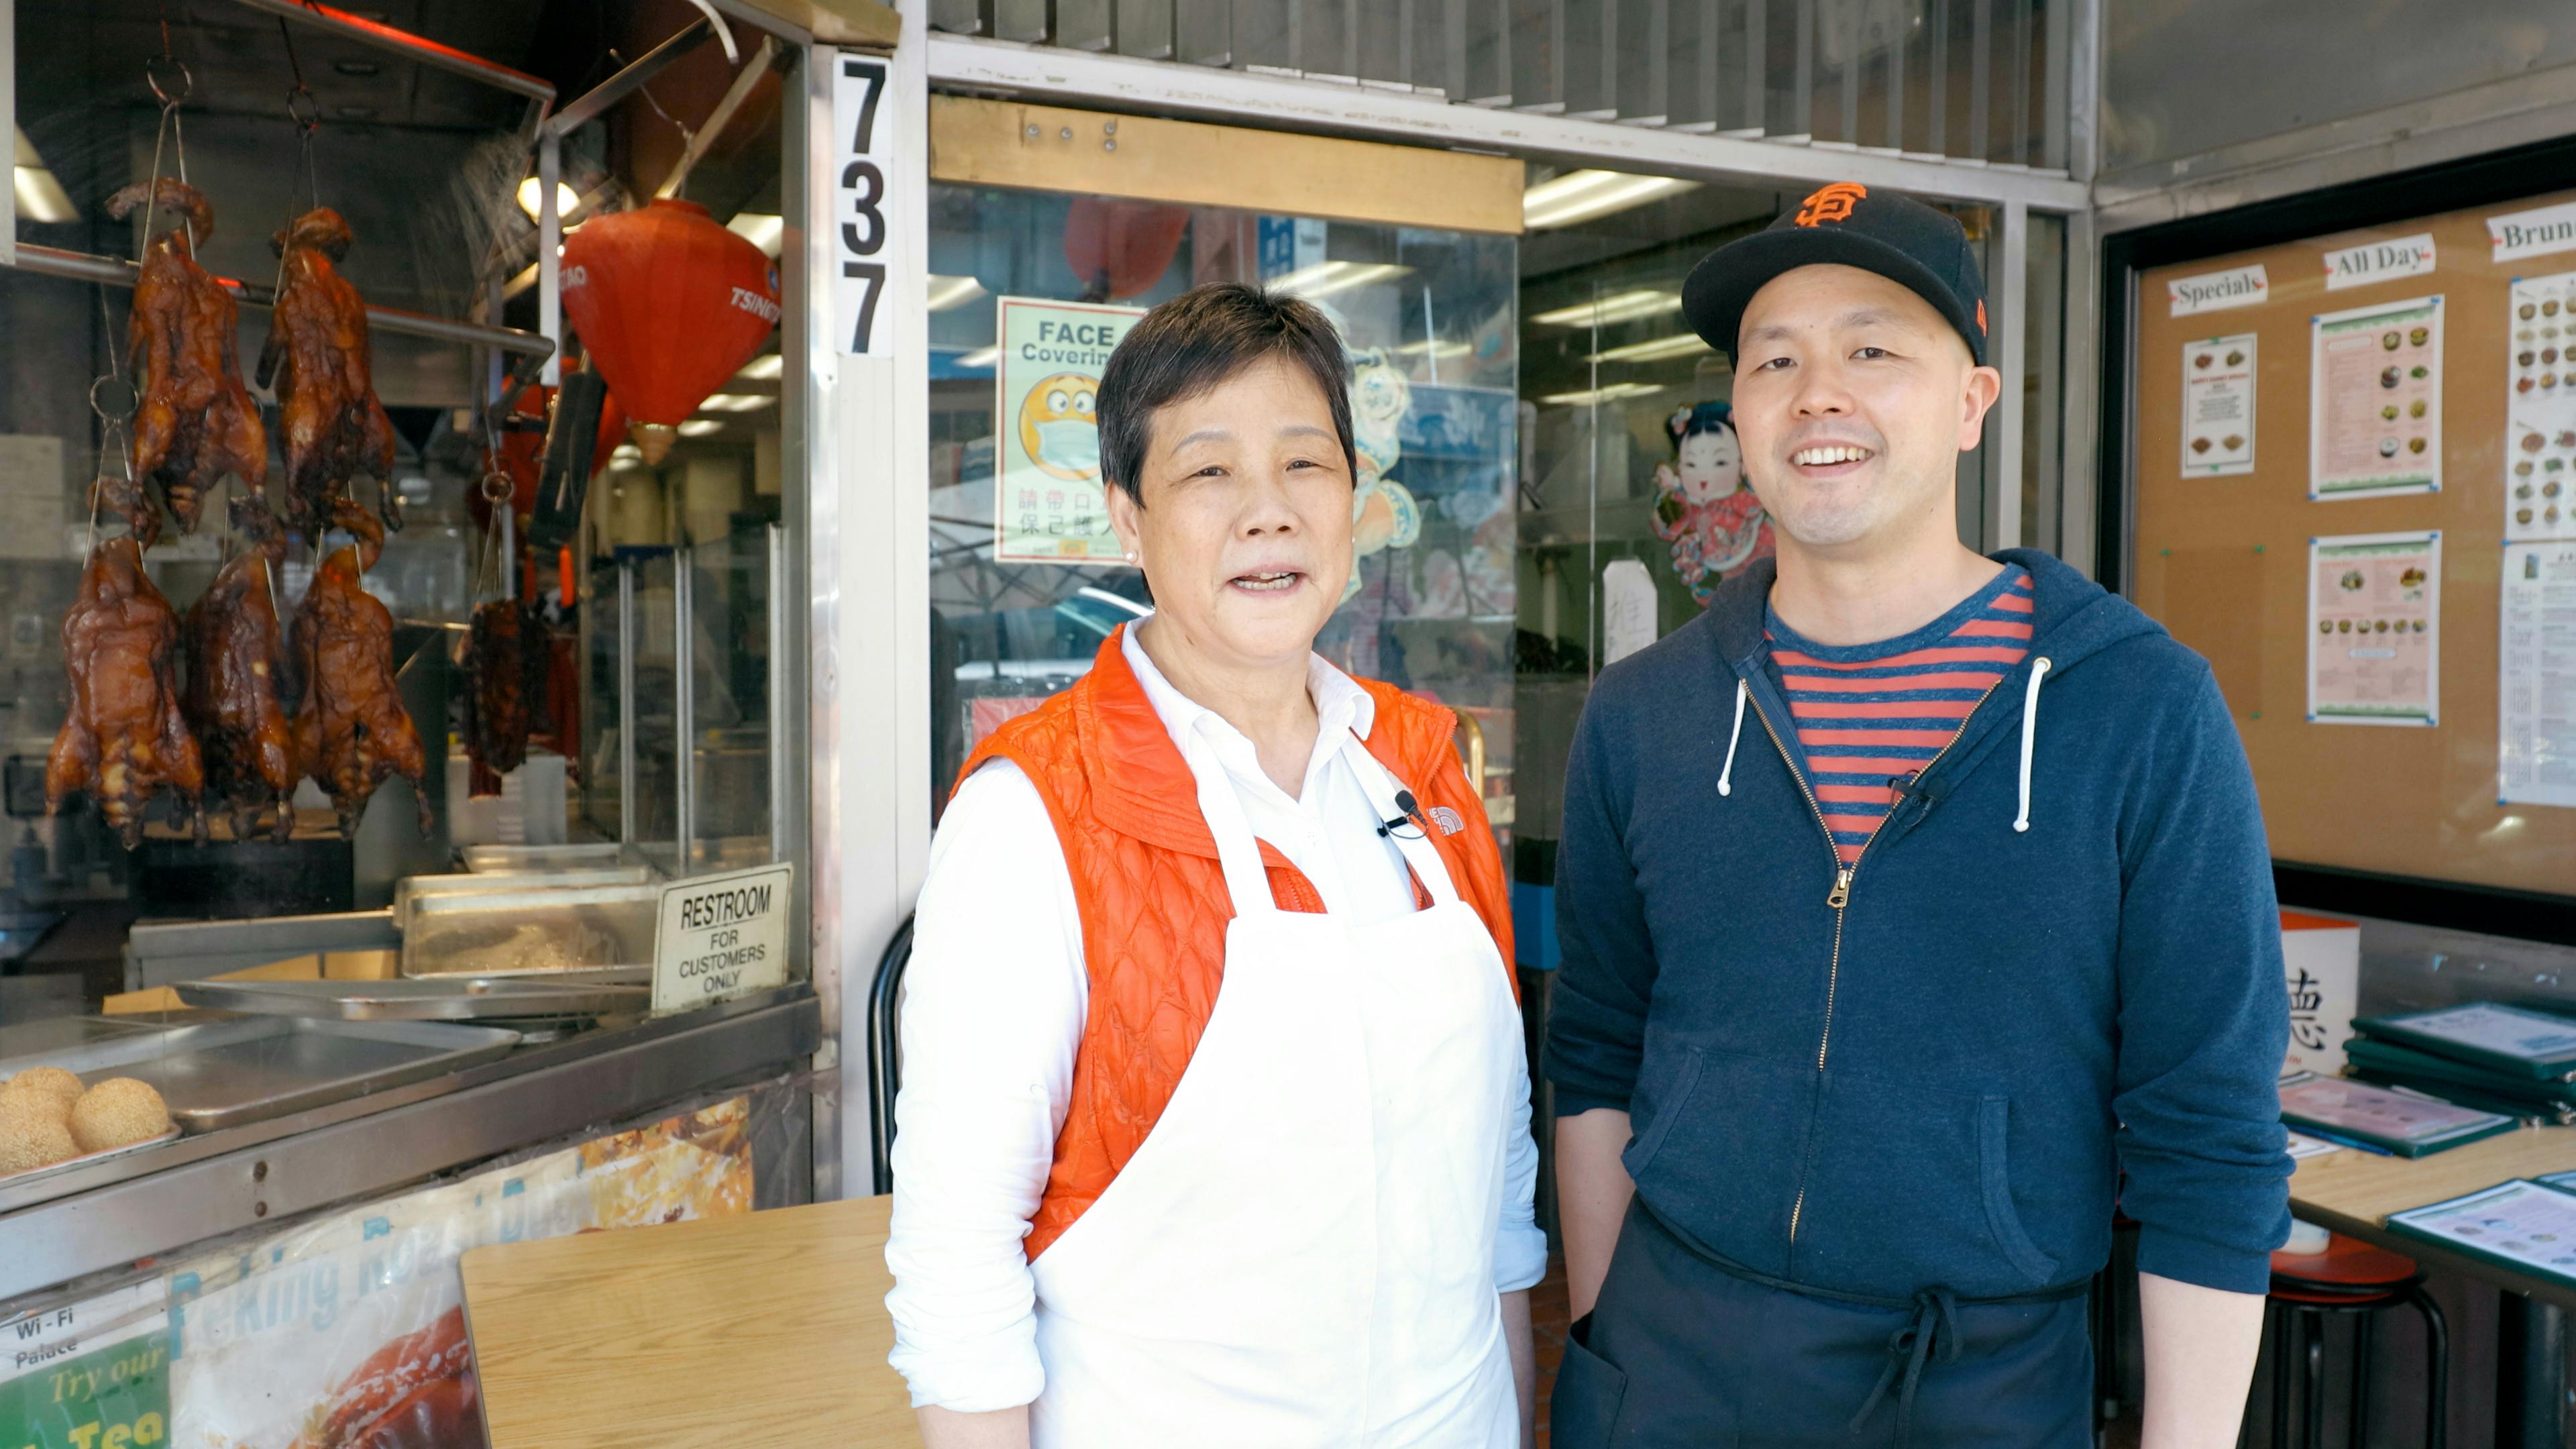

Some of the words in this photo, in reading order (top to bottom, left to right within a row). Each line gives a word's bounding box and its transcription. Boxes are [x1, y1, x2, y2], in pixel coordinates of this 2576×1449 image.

[841, 59, 886, 354] 737
[2504, 220, 2576, 249] Brun
[2337, 252, 2369, 277] All
[2377, 244, 2426, 271] Day
[2178, 272, 2260, 308] Specials
[1039, 320, 1114, 346] FACE
[1018, 488, 1106, 511] 請帶口
[681, 883, 771, 930] RESTROOM
[710, 929, 739, 951] FOR
[679, 943, 765, 978] CUSTOMERS
[704, 971, 741, 993] ONLY
[49, 1366, 103, 1403] Try
[109, 1347, 165, 1382] our
